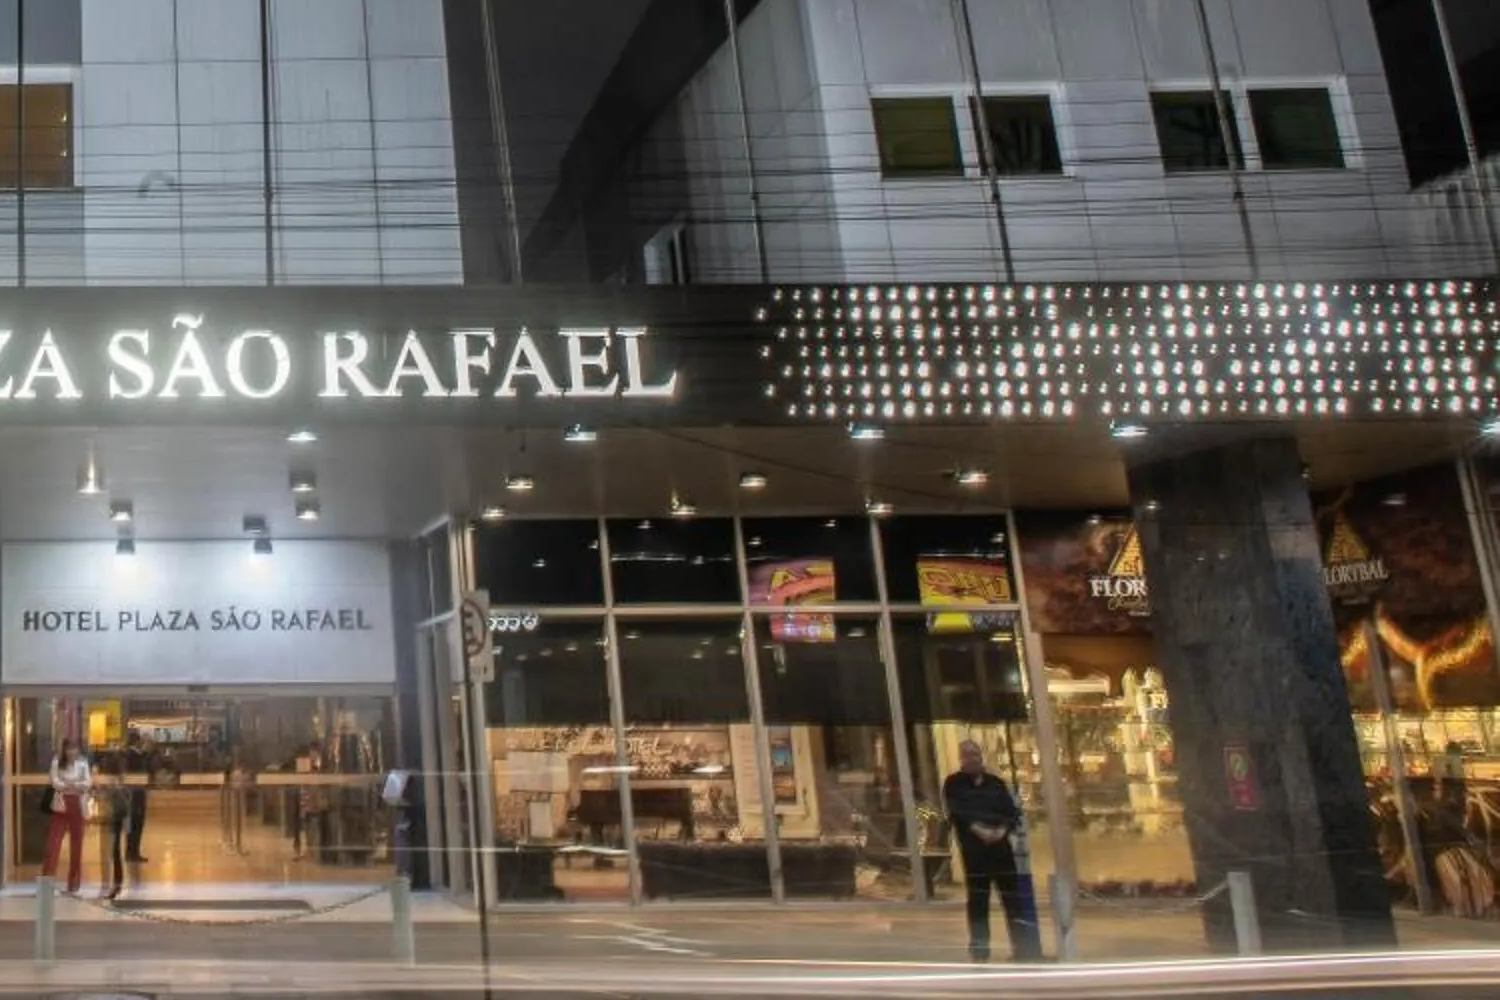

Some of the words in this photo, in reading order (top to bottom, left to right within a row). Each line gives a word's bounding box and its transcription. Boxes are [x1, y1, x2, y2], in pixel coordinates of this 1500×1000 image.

[107, 312, 292, 399] SÃO
[317, 325, 679, 398] RAFAEL
[1089, 576, 1149, 597] FLOR
[23, 609, 109, 633] HOTEL
[118, 609, 200, 633] PLAZA
[211, 604, 261, 632] SÃO
[271, 608, 374, 632] RAFAEL
